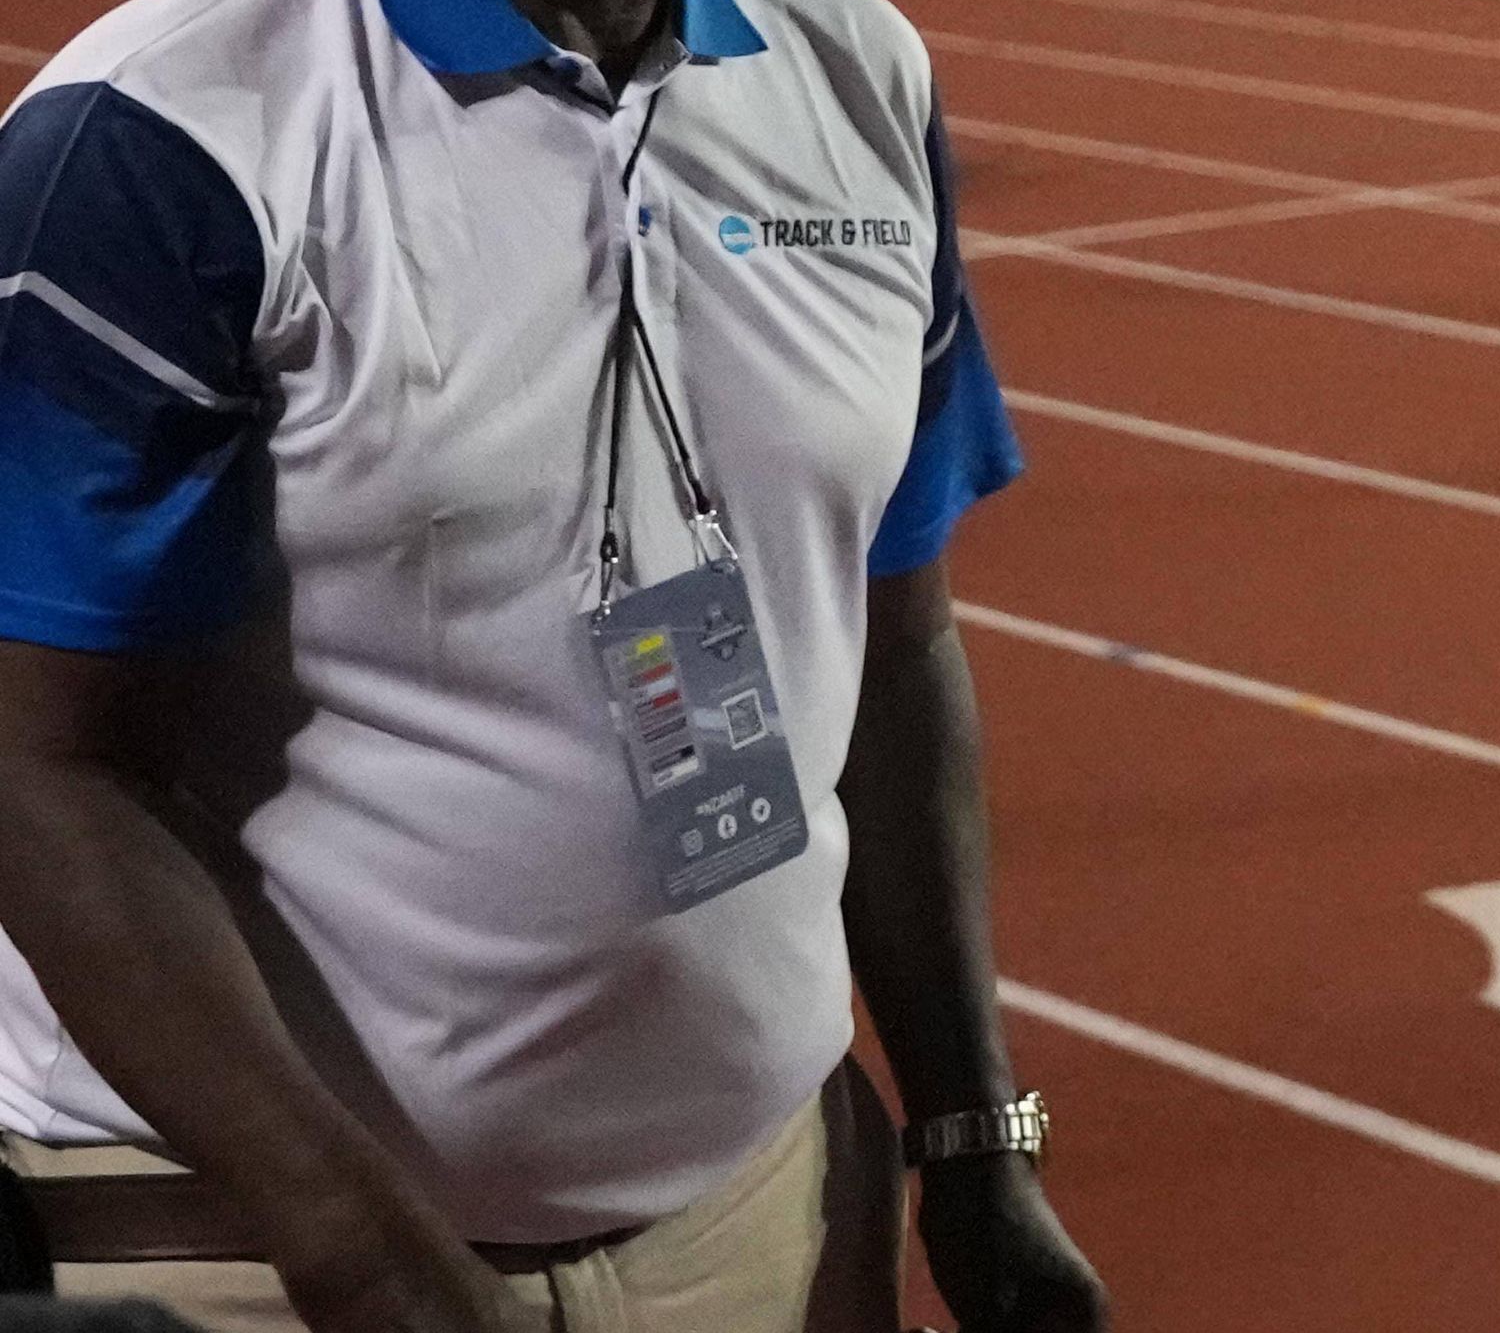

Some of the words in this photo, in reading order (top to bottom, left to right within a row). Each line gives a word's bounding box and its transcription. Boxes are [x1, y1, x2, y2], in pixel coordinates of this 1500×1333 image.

[760, 219, 835, 247] TRACK
[841, 219, 856, 245] &
[862, 219, 911, 247] FIELD
